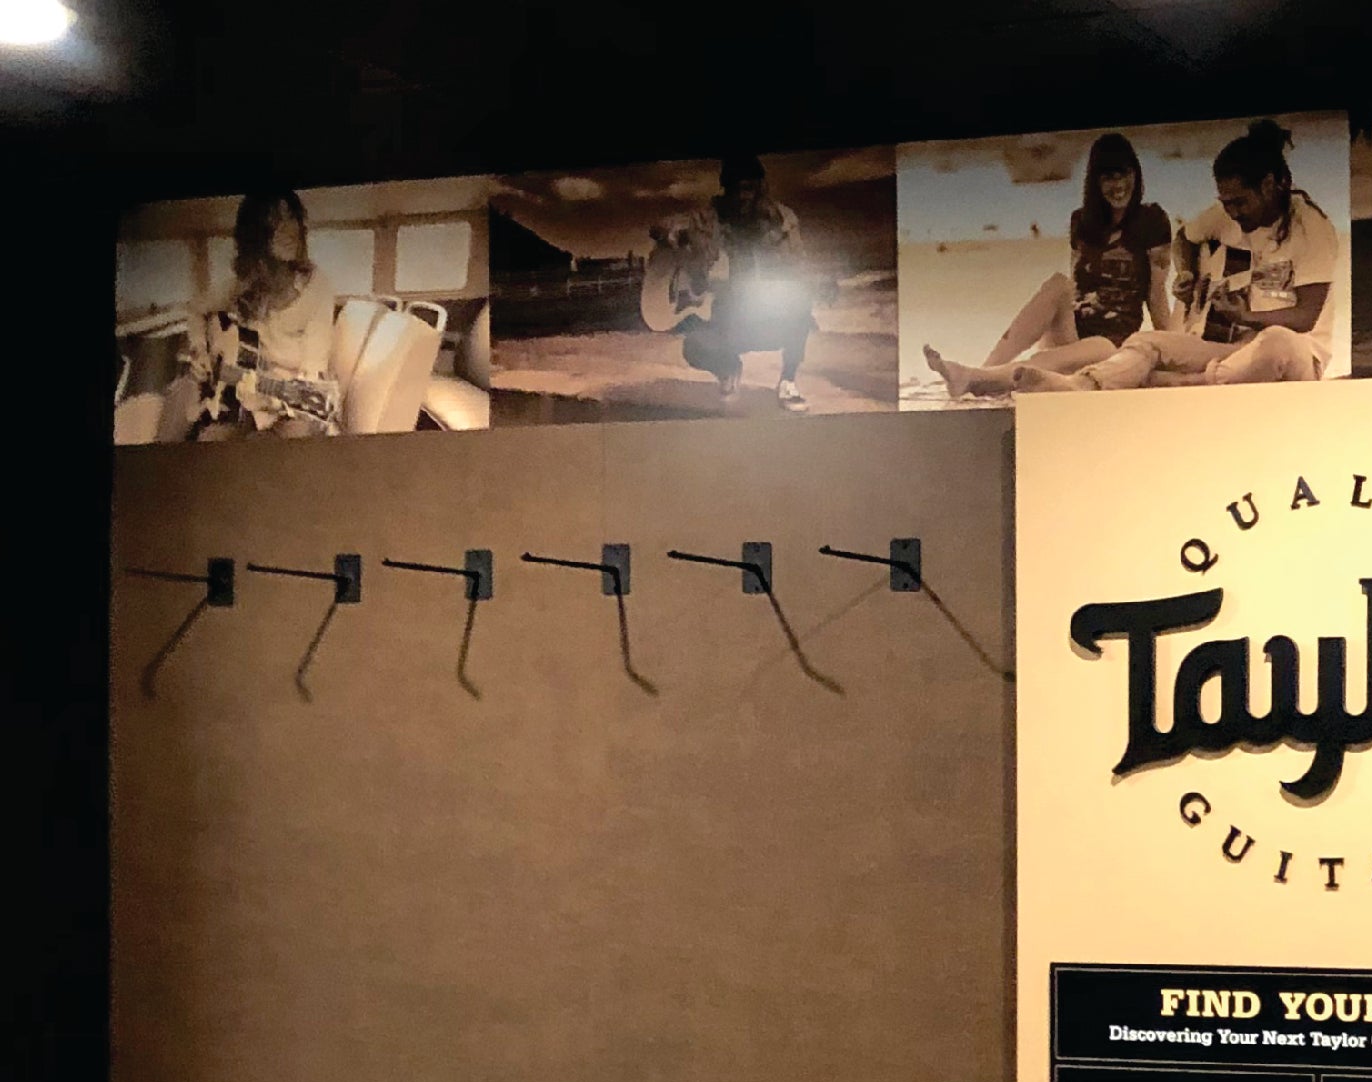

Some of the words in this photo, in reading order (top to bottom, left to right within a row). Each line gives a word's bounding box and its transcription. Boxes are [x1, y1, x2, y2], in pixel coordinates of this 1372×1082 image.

[1161, 989, 1261, 1018] FIND
[1109, 1025, 1213, 1046] Discovering
[1217, 1029, 1259, 1044] Your
[1262, 1030, 1306, 1046] Next
[1310, 1032, 1367, 1050] Taylor
